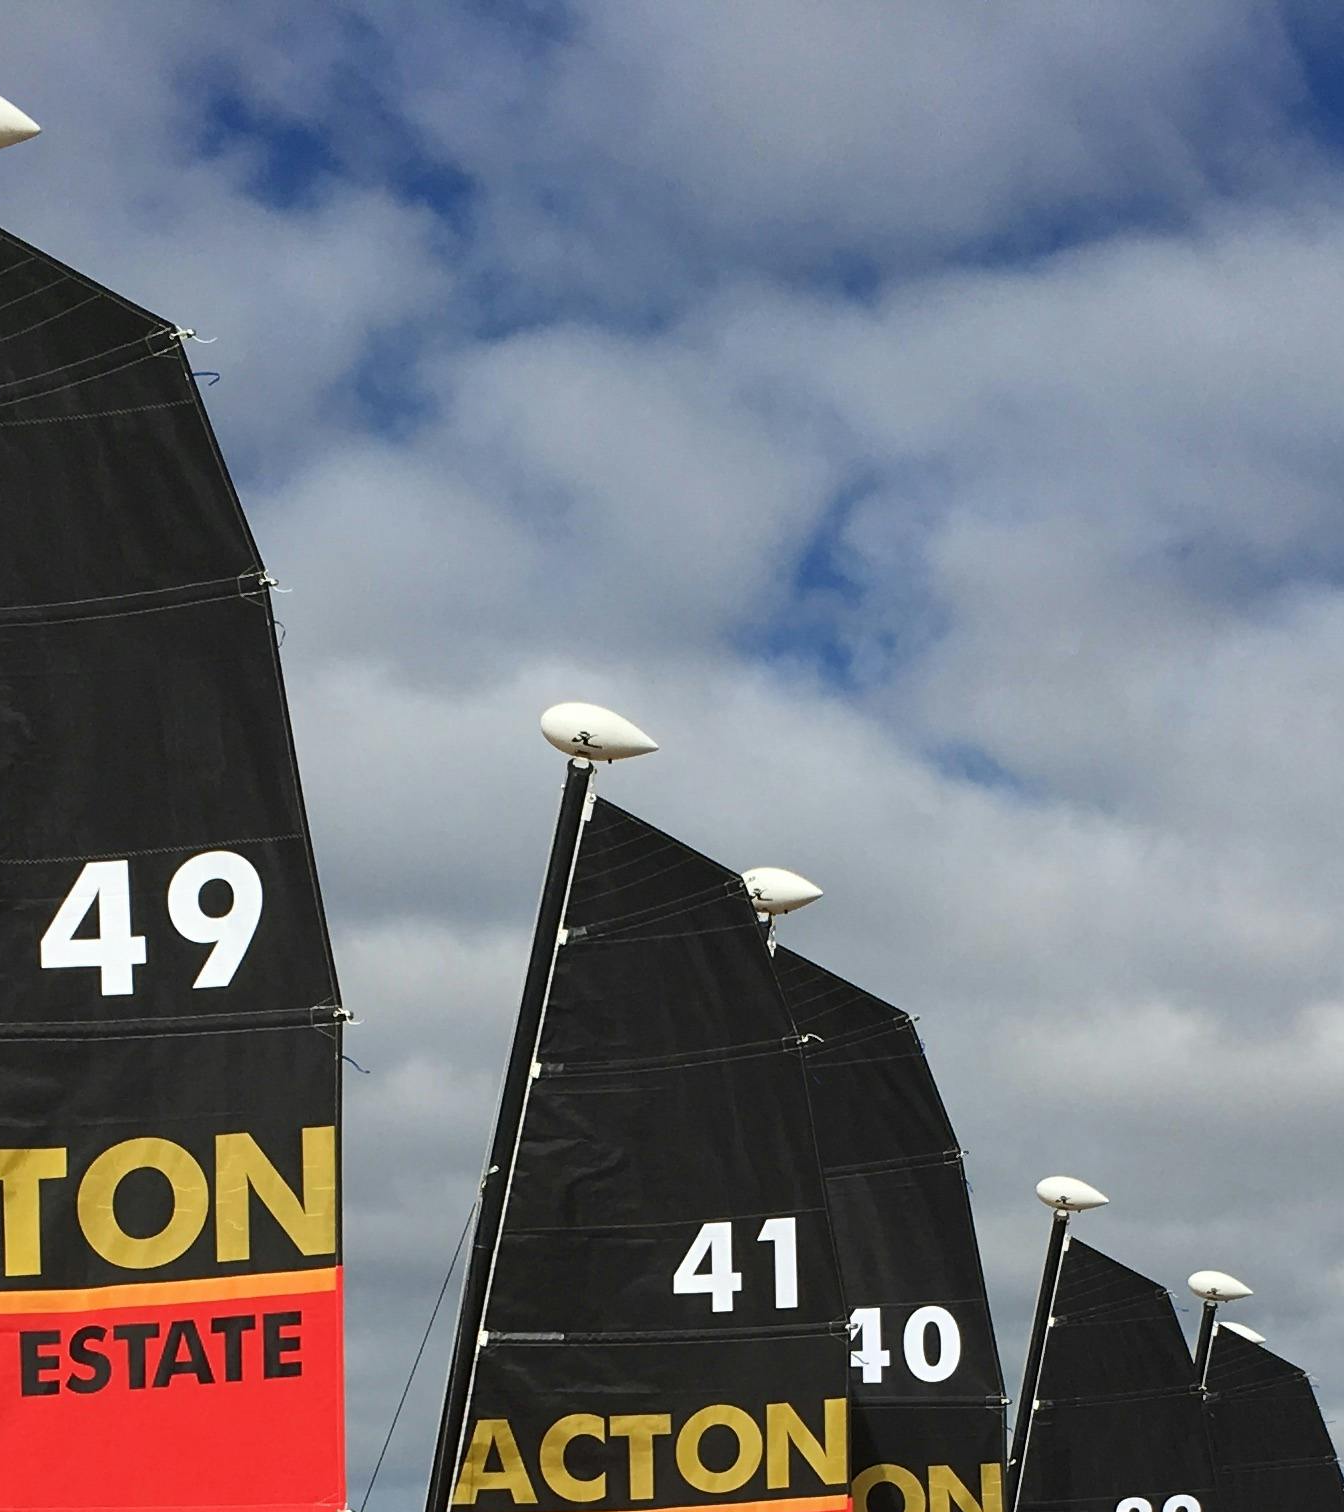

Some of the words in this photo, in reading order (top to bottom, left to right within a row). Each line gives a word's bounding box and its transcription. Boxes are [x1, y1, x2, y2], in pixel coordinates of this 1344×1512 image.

[40, 850, 263, 996] 49
[673, 1217, 798, 1312] 41
[20, 1312, 302, 1397] ESTATE
[850, 1306, 961, 1384] 40
[450, 1398, 848, 1505] ACTON
